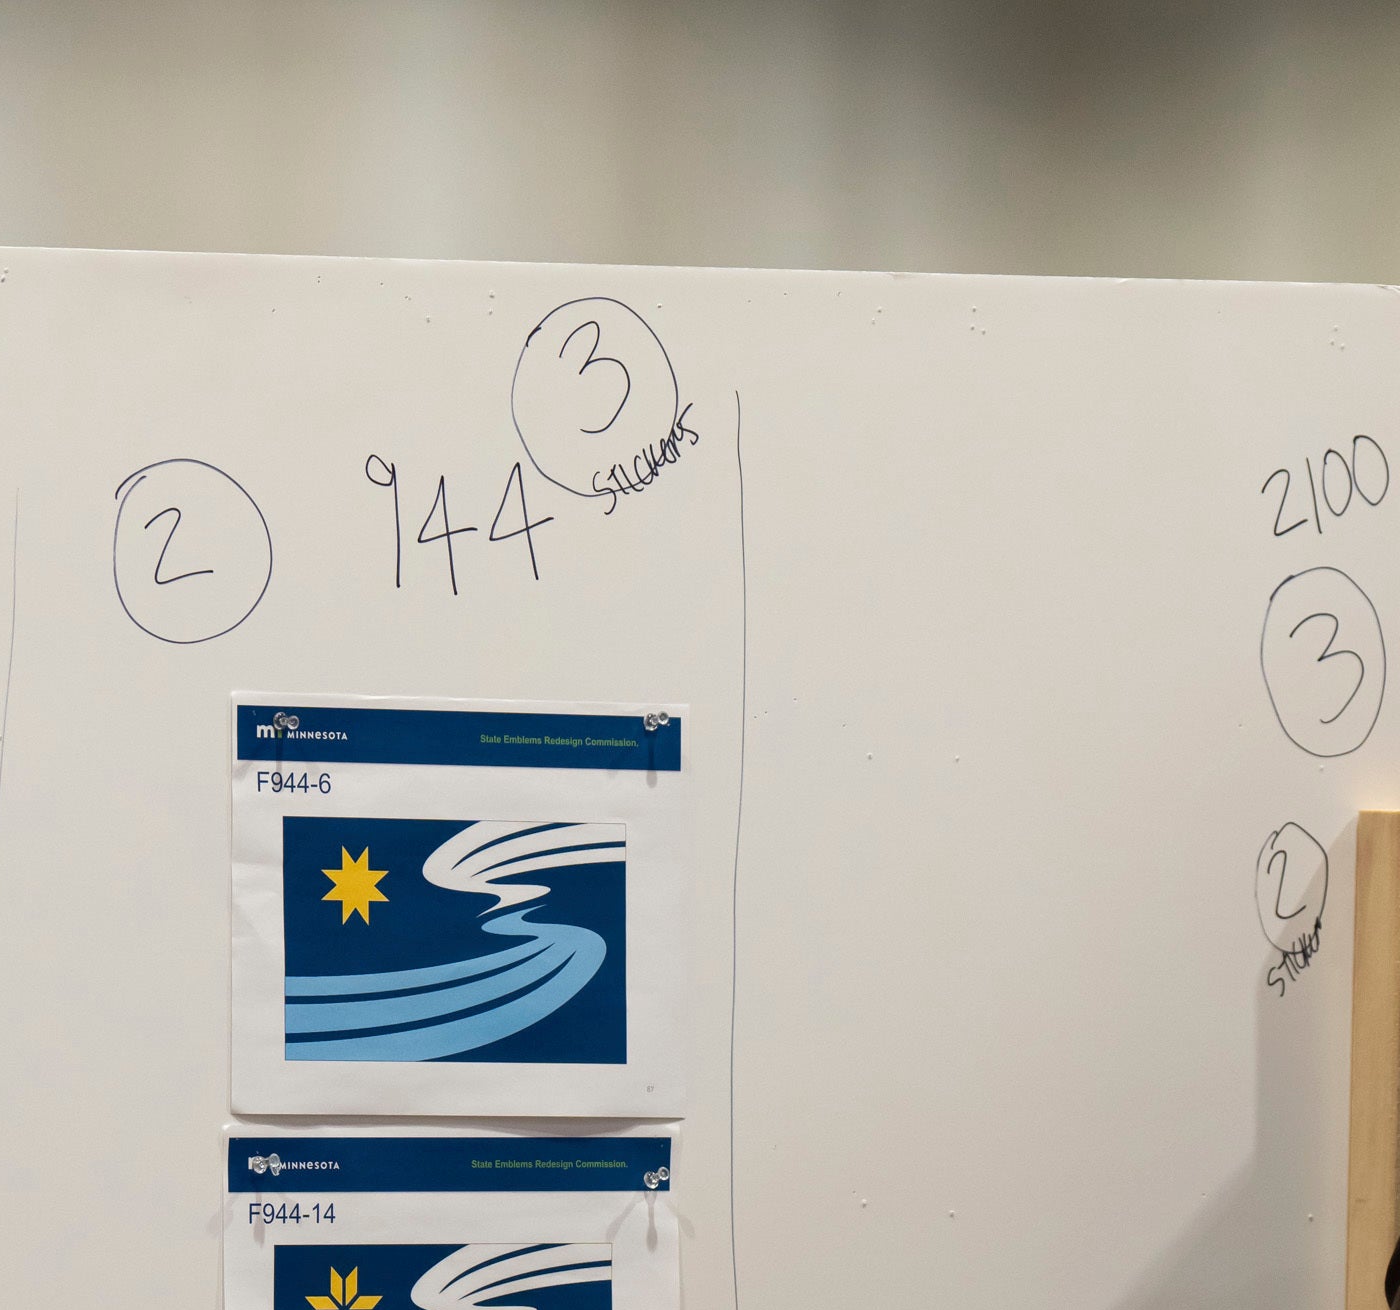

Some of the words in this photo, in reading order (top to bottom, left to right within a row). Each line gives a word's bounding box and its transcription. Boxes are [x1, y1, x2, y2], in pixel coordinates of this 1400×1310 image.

[559, 320, 630, 433] 3
[1261, 434, 1389, 536] 2100
[145, 508, 213, 584] 2
[365, 455, 554, 596] 944
[1289, 612, 1365, 724] 3
[480, 734, 501, 743] State
[504, 735, 542, 744] Emblems
[544, 736, 583, 747] Redesign
[257, 771, 332, 794] F944-6
[1267, 850, 1306, 919] 2
[471, 1160, 493, 1168] State
[495, 1160, 533, 1168] Emblems
[535, 1160, 573, 1170] Redesign
[576, 1160, 628, 1168] Commission.
[249, 1203, 336, 1224] F944-14
